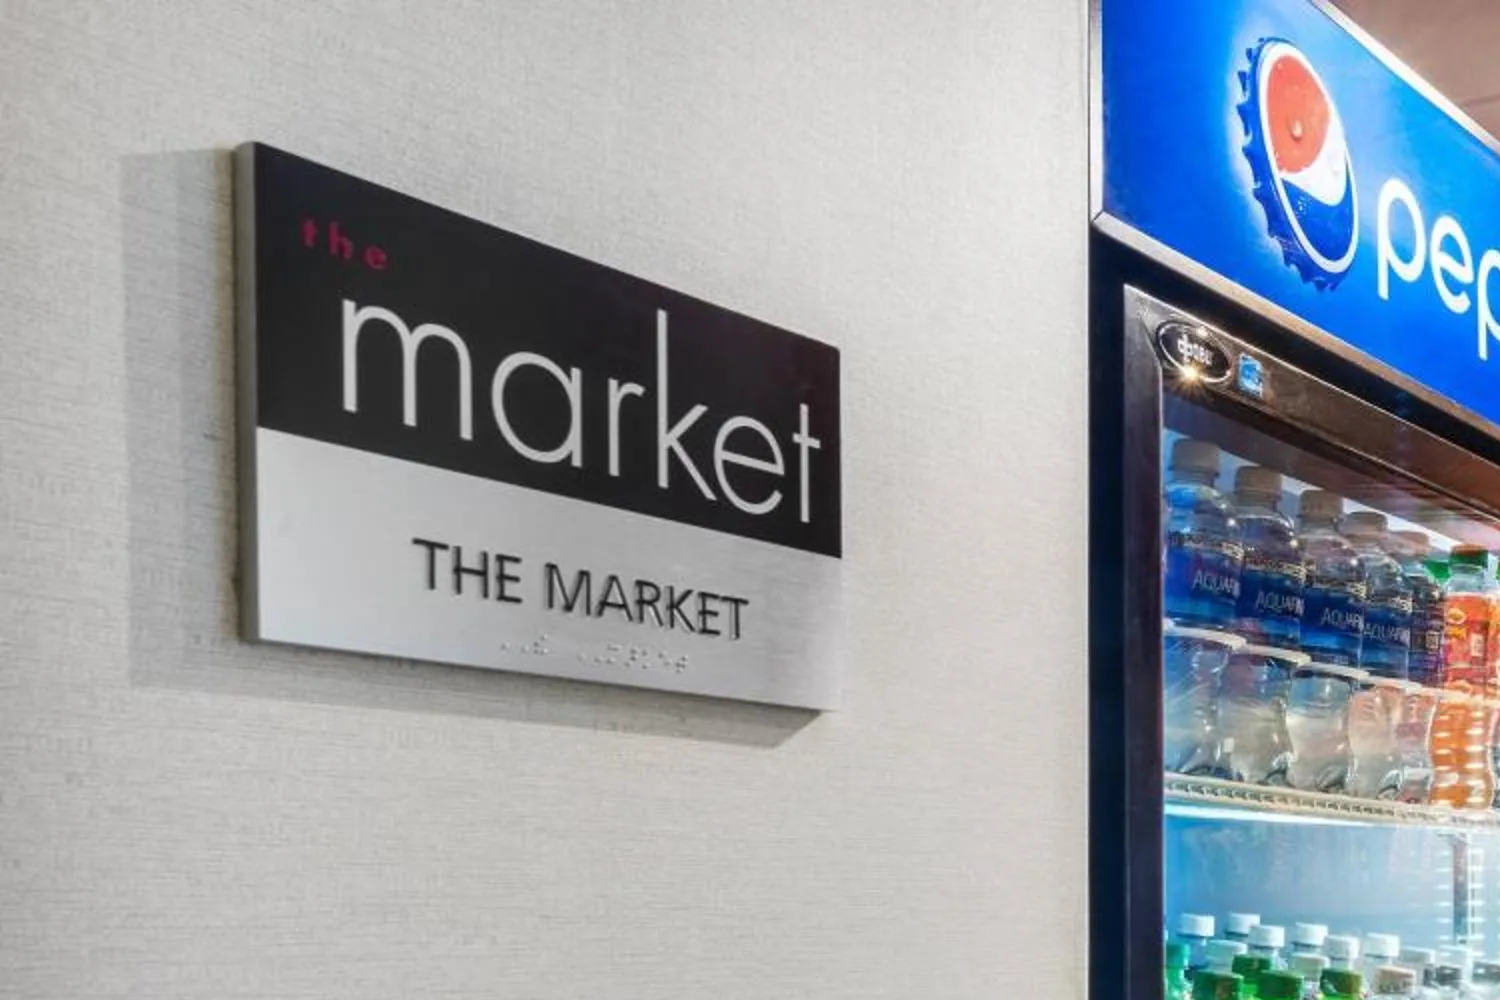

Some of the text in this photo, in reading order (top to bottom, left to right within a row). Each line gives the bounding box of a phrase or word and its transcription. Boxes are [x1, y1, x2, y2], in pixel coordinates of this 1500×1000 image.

[303, 216, 388, 270] the
[342, 299, 821, 523] market
[412, 537, 749, 640] THE MARKET
